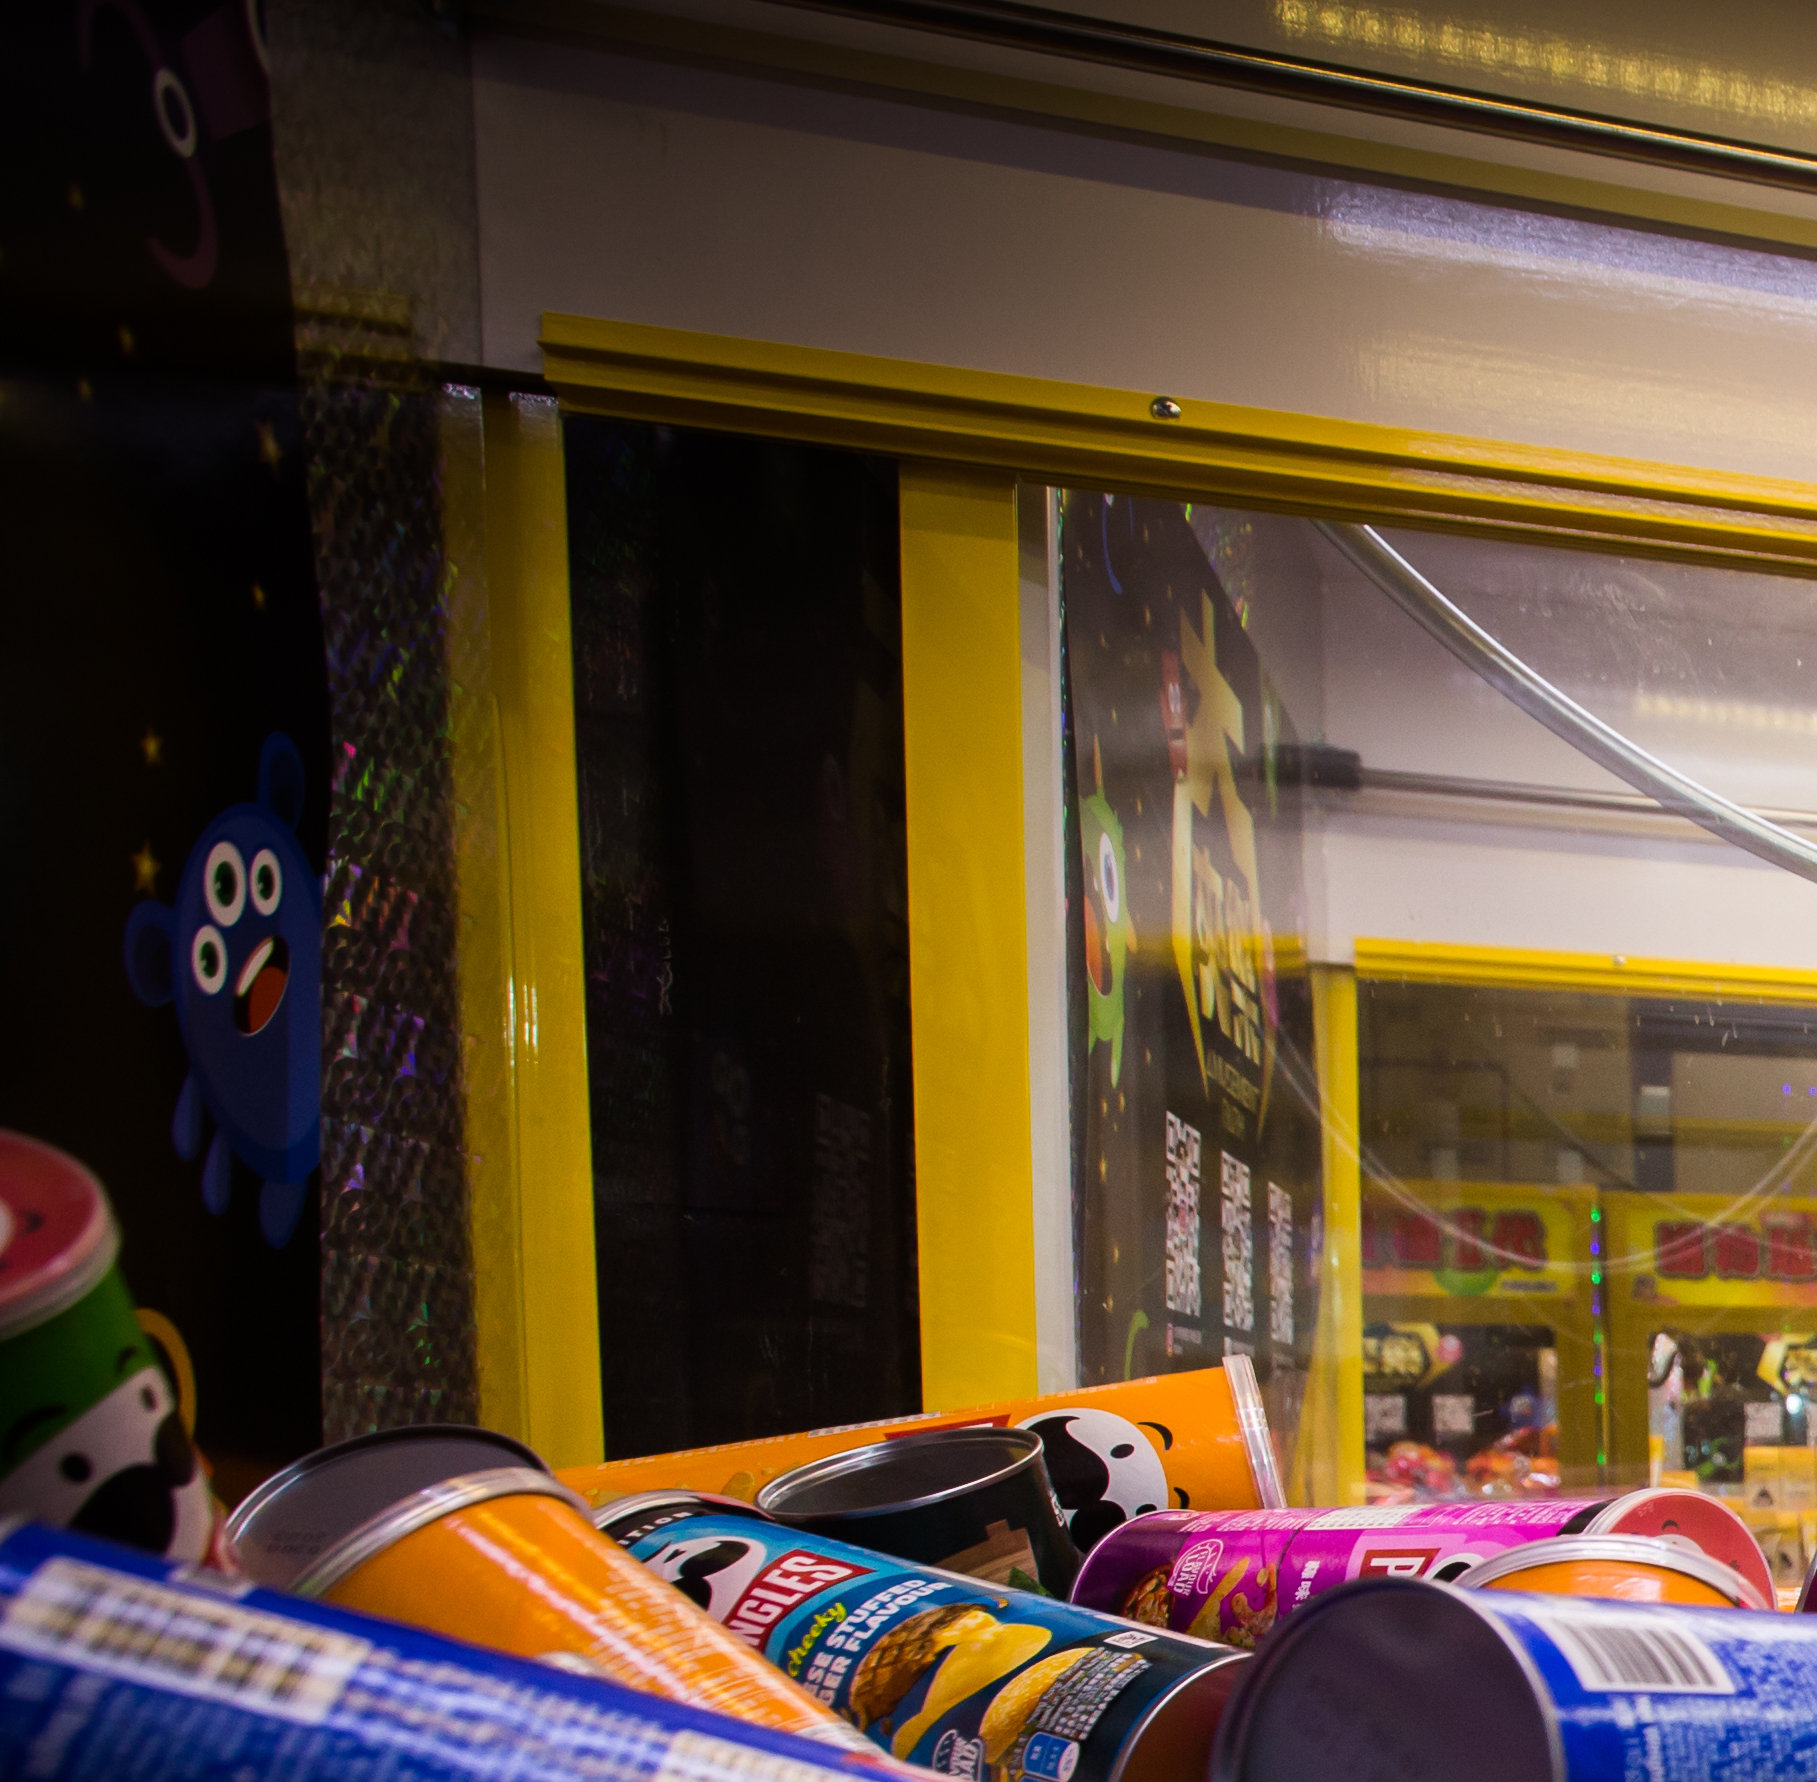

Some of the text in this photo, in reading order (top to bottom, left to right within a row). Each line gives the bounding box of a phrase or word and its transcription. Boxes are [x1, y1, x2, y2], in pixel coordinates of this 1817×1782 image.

[618, 1511, 693, 1548] ITION
[727, 1552, 854, 1646] NGLES
[826, 1579, 927, 1649] STUFFED
[849, 1580, 954, 1654] FLAVOUR
